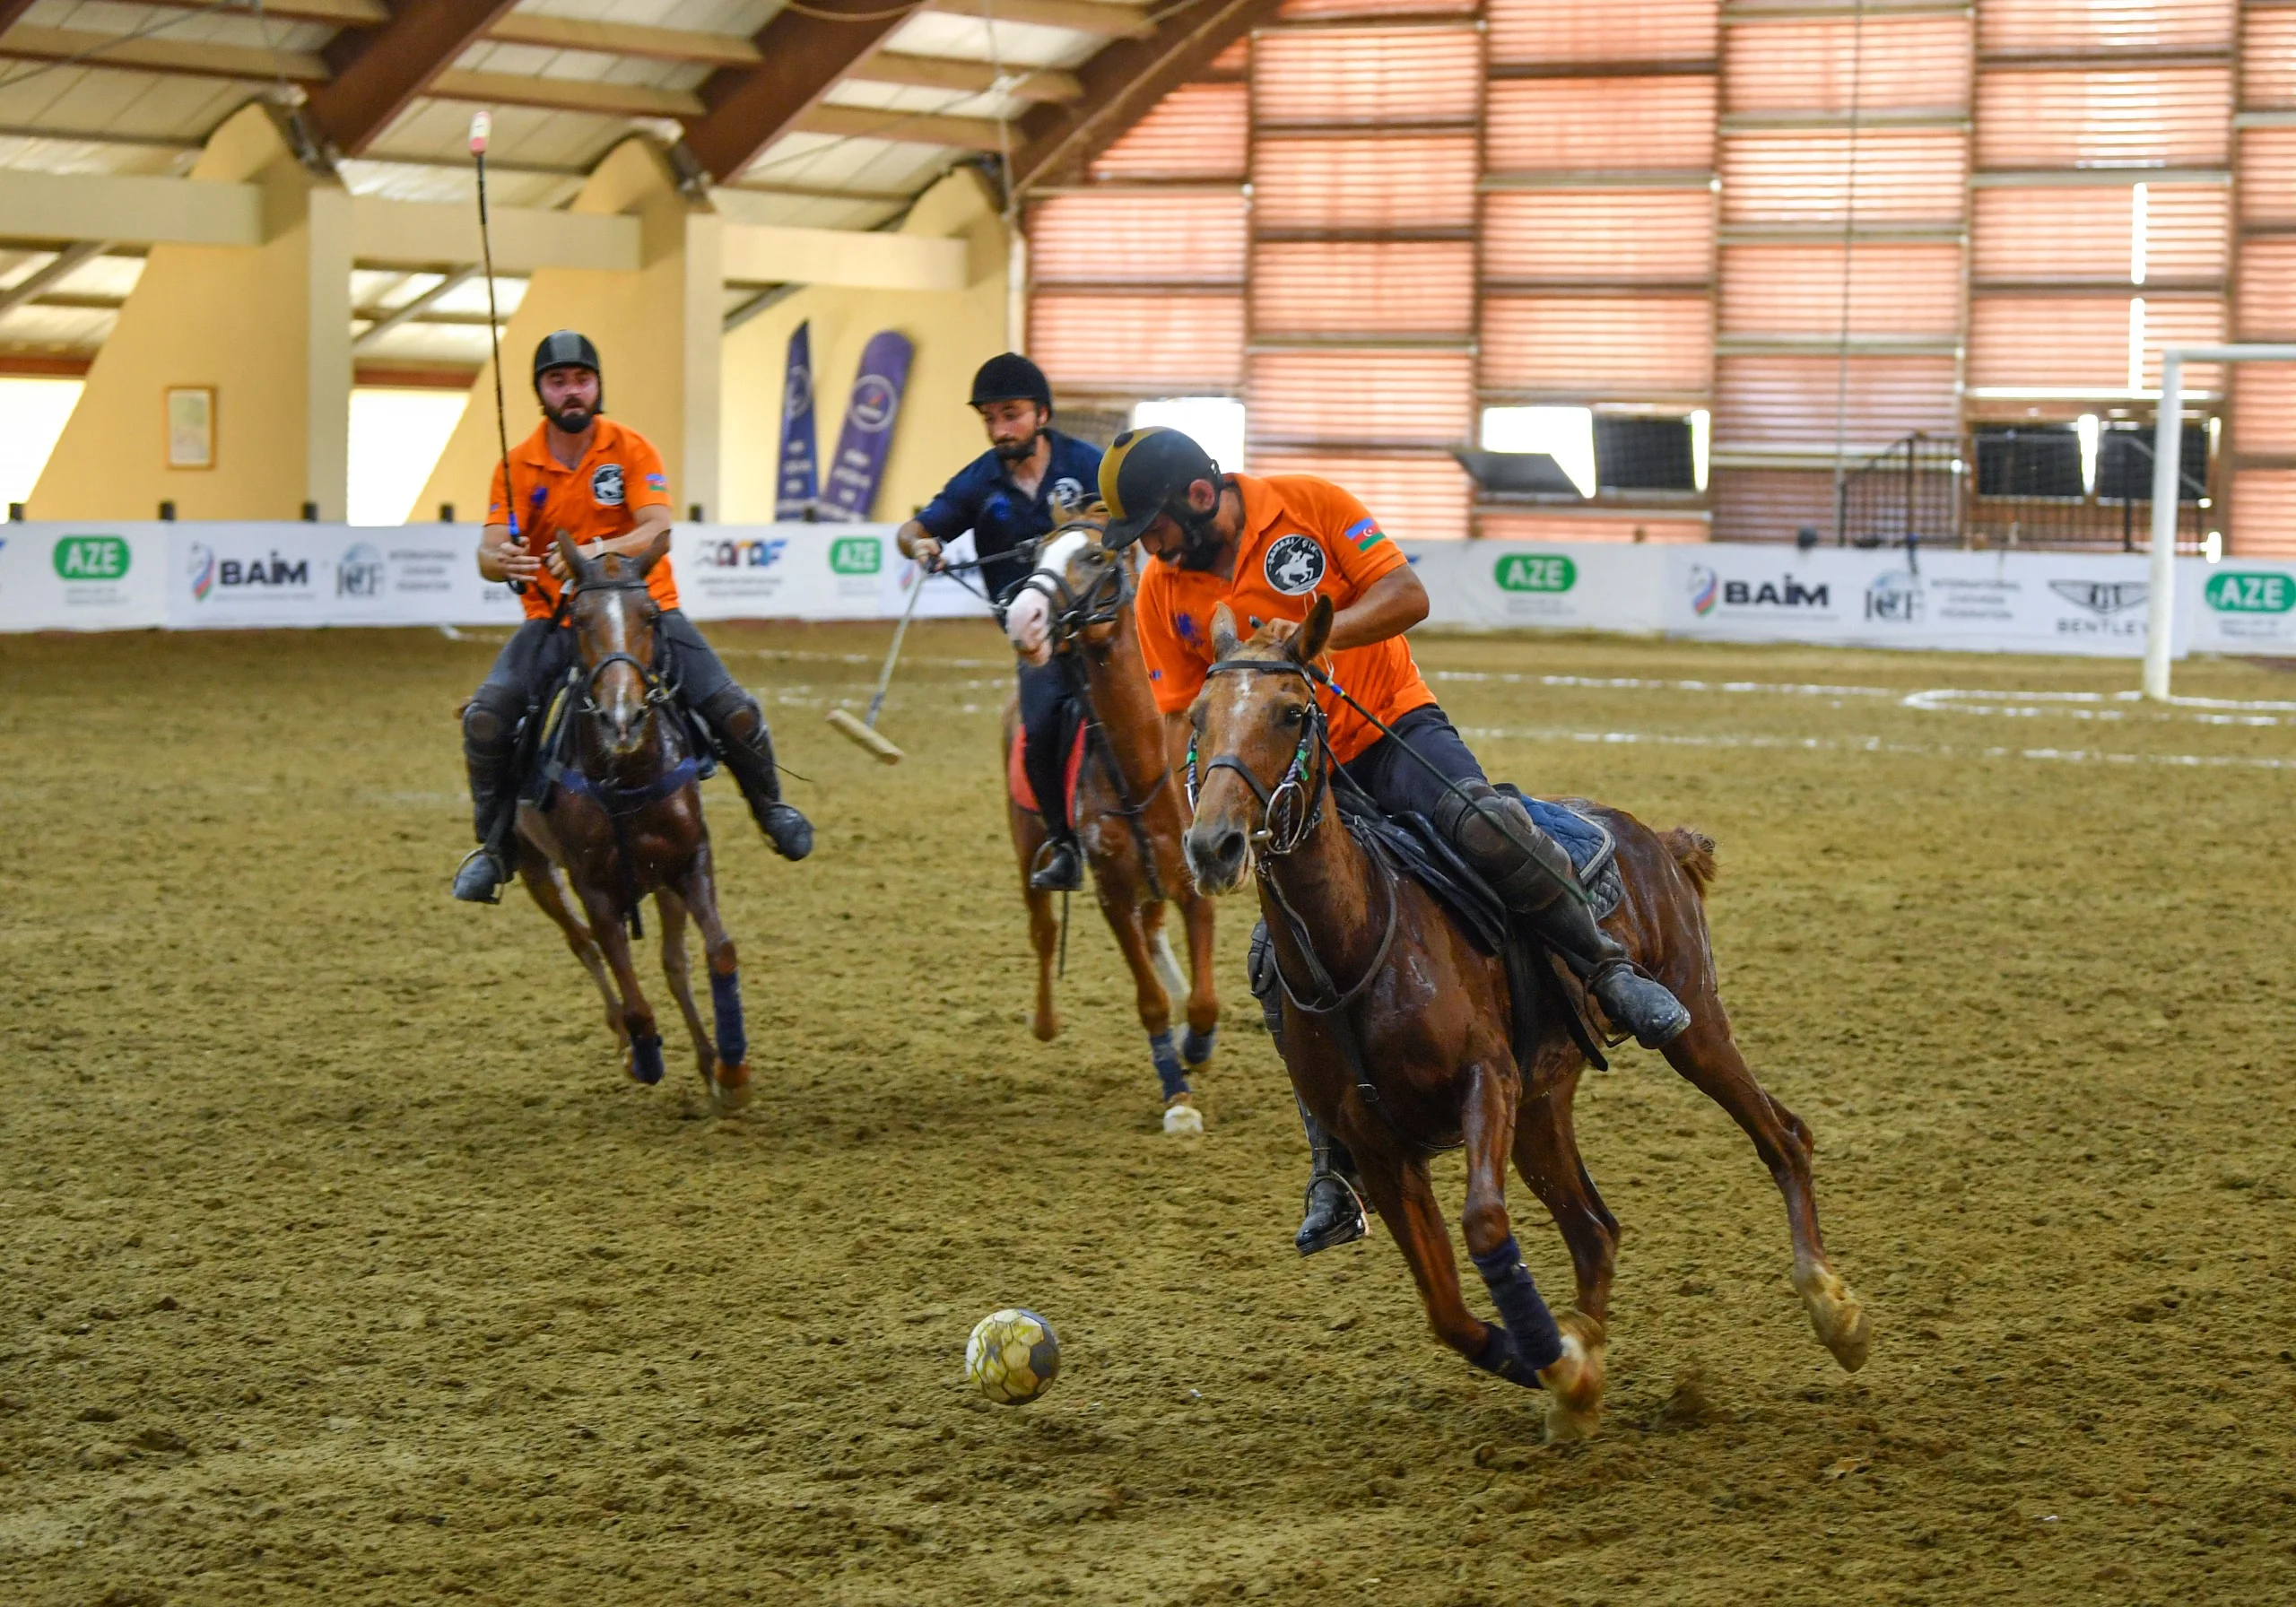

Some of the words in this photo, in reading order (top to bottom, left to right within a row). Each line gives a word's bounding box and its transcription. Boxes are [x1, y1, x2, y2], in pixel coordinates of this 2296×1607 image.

[65, 540, 120, 575] AZE
[837, 541, 877, 570] AZE
[1507, 558, 1565, 588] AZE
[2219, 575, 2285, 610] AZE
